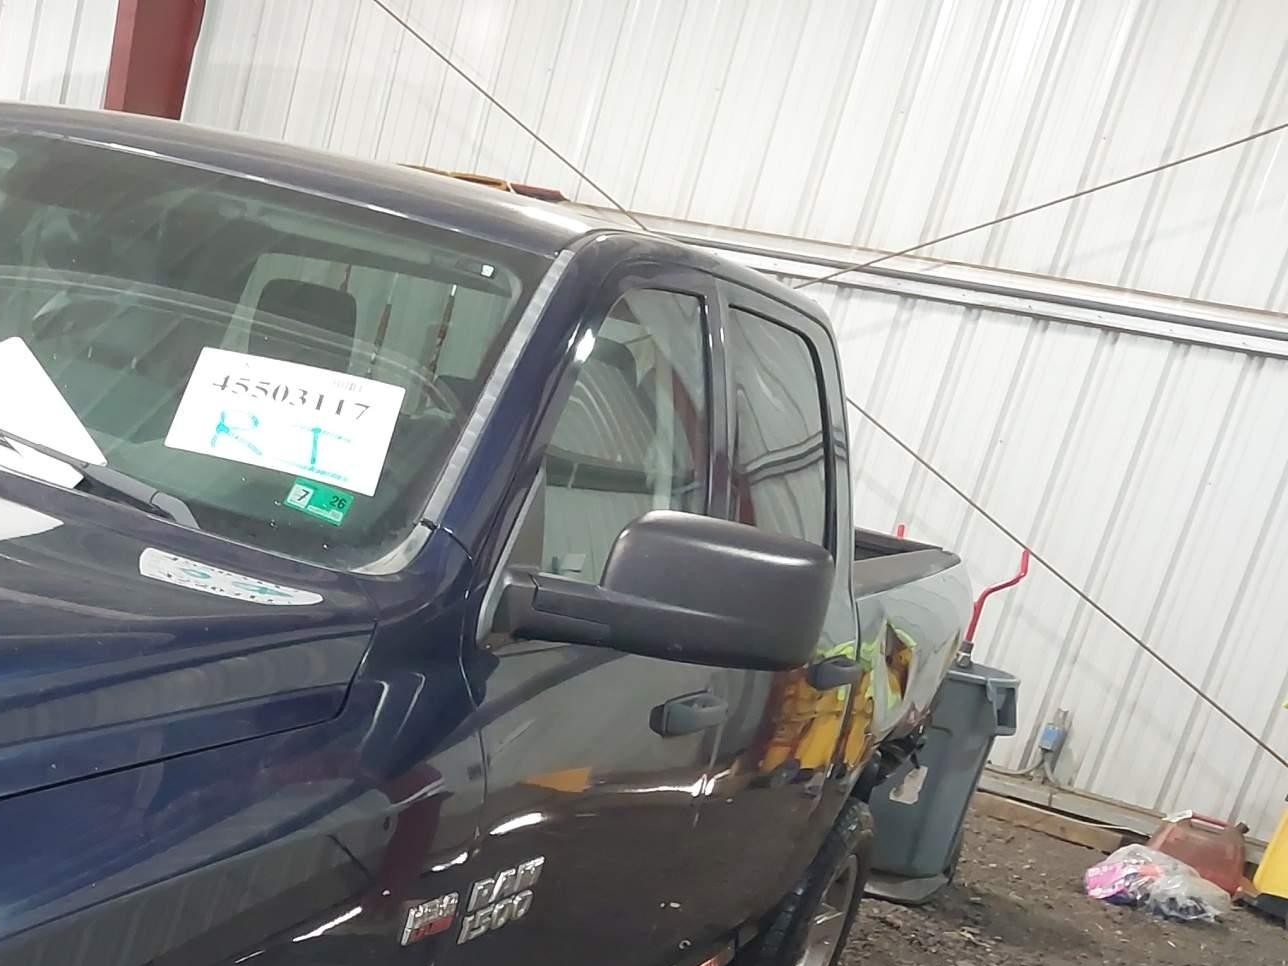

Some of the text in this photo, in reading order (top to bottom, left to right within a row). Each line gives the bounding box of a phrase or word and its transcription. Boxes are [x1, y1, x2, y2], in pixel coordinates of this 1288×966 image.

[212, 374, 371, 421] 45503117
[297, 488, 310, 501] 7
[329, 495, 347, 509] 26
[456, 889, 534, 944] 1500
